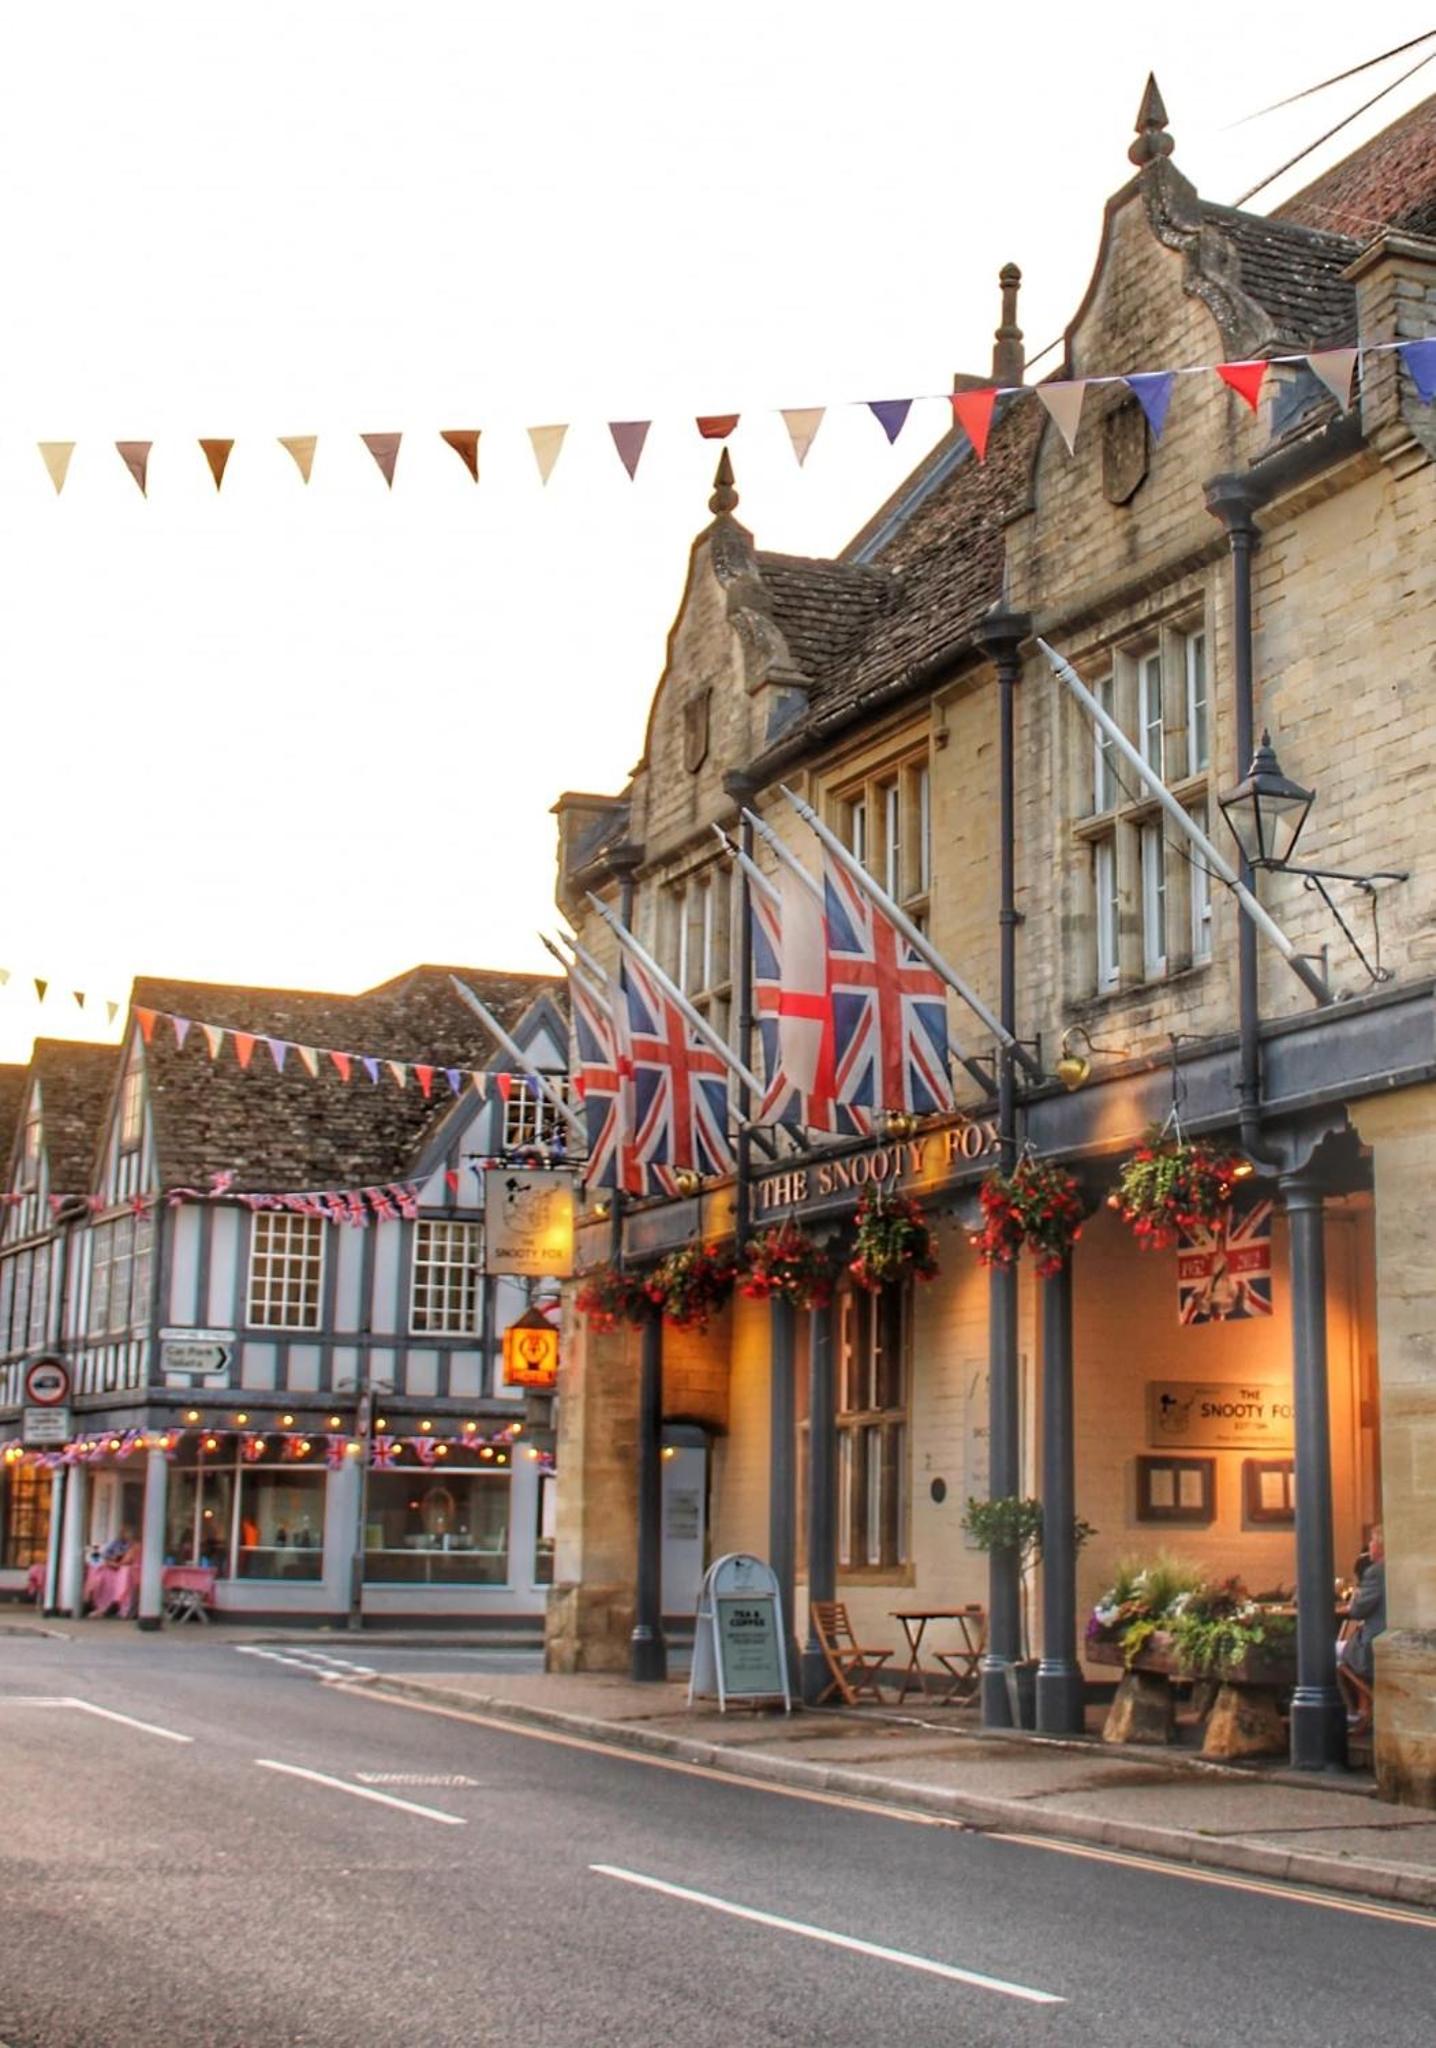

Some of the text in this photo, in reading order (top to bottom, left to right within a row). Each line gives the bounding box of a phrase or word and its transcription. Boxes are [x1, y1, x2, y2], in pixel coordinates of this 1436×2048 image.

[758, 1119, 1001, 1209] THE SNOOTY FOX
[1240, 1390, 1260, 1401] THE
[1201, 1403, 1294, 1419] SNOOTY FO
[733, 1609, 751, 1618] TEA
[729, 1618, 766, 1627] COFFEE
